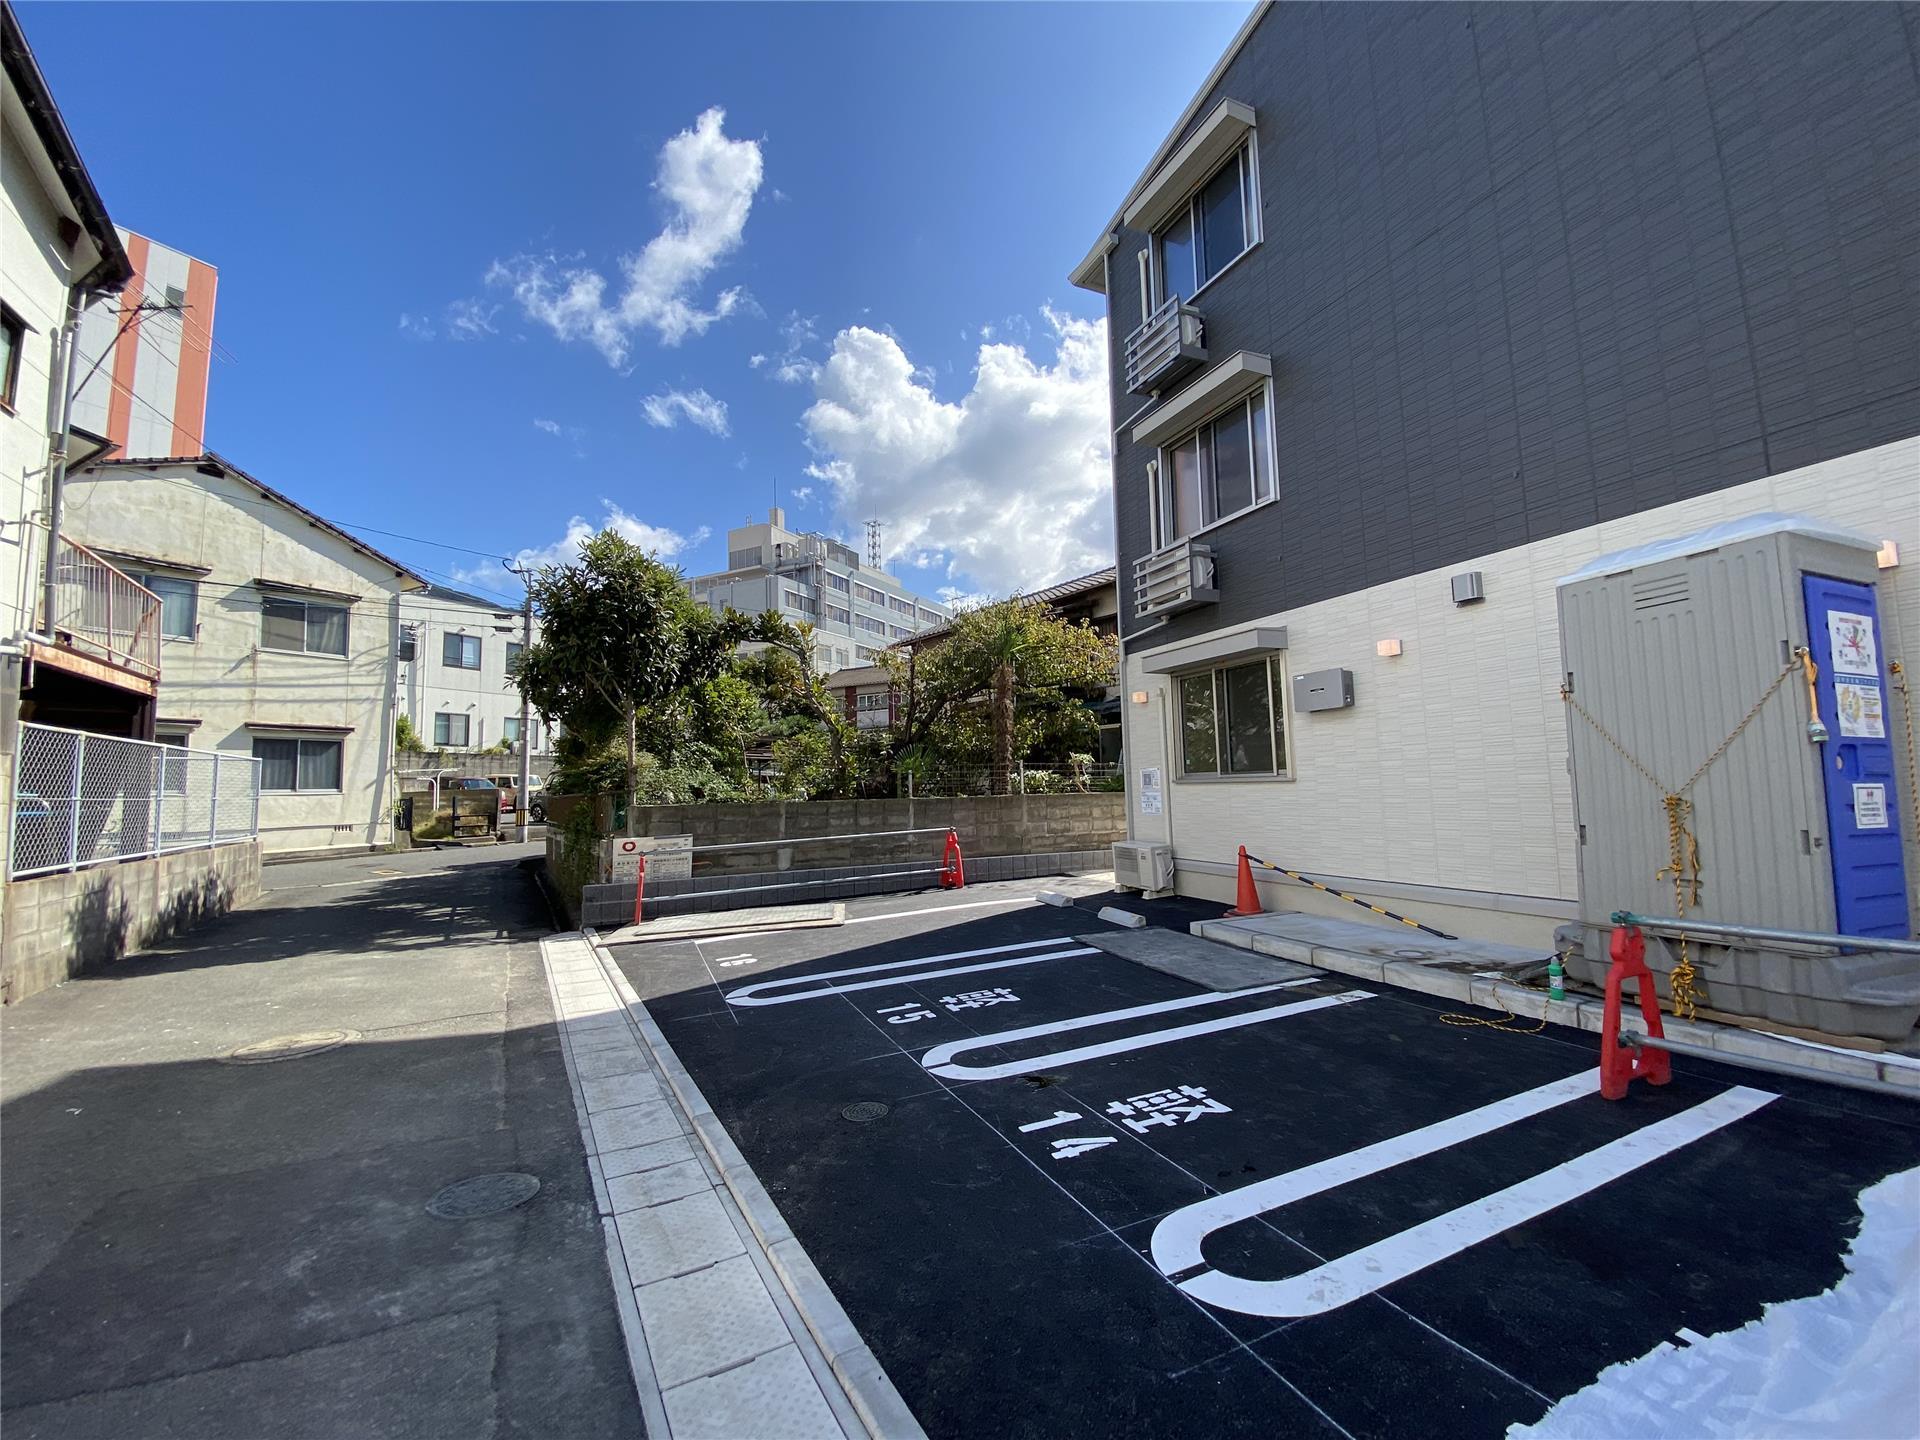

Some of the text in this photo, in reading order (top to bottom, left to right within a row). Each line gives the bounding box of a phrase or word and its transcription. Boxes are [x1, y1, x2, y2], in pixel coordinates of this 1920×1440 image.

[715, 953, 758, 967] 16
[939, 987, 1021, 1012] 軽
[876, 1002, 937, 1024] 15
[1106, 1084, 1233, 1134] 軽
[1018, 1110, 1118, 1160] 14
